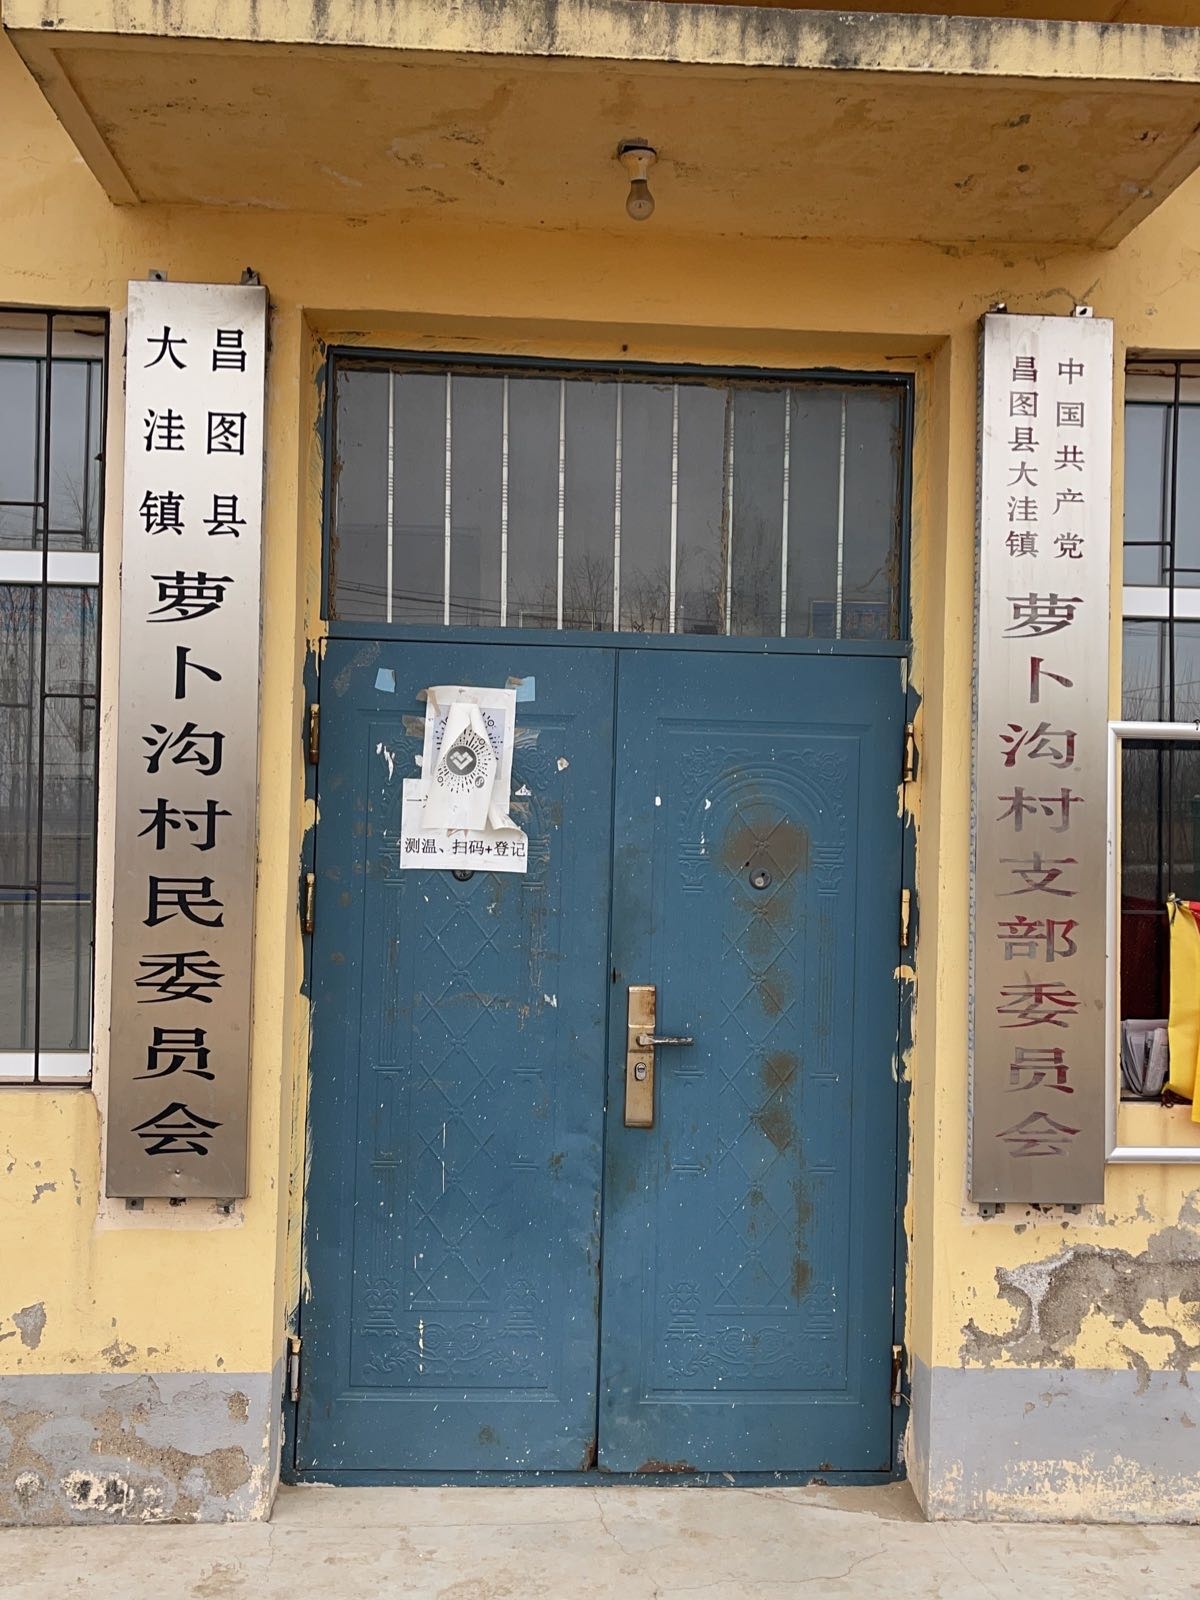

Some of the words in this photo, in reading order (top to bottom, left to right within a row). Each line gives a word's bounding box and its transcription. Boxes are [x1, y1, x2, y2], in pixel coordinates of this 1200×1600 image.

[138, 325, 188, 536] 大洼镇
[202, 328, 248, 539] 昌图县
[1005, 355, 1040, 559] 昌图县大洼镇
[1052, 357, 1086, 560] 中国共产党
[130, 570, 235, 1157] 萝卜沟村民委员会
[404, 837, 526, 858] 测温、扫码+登记
[995, 592, 1085, 1159] 萝卜沟村支部委员会
